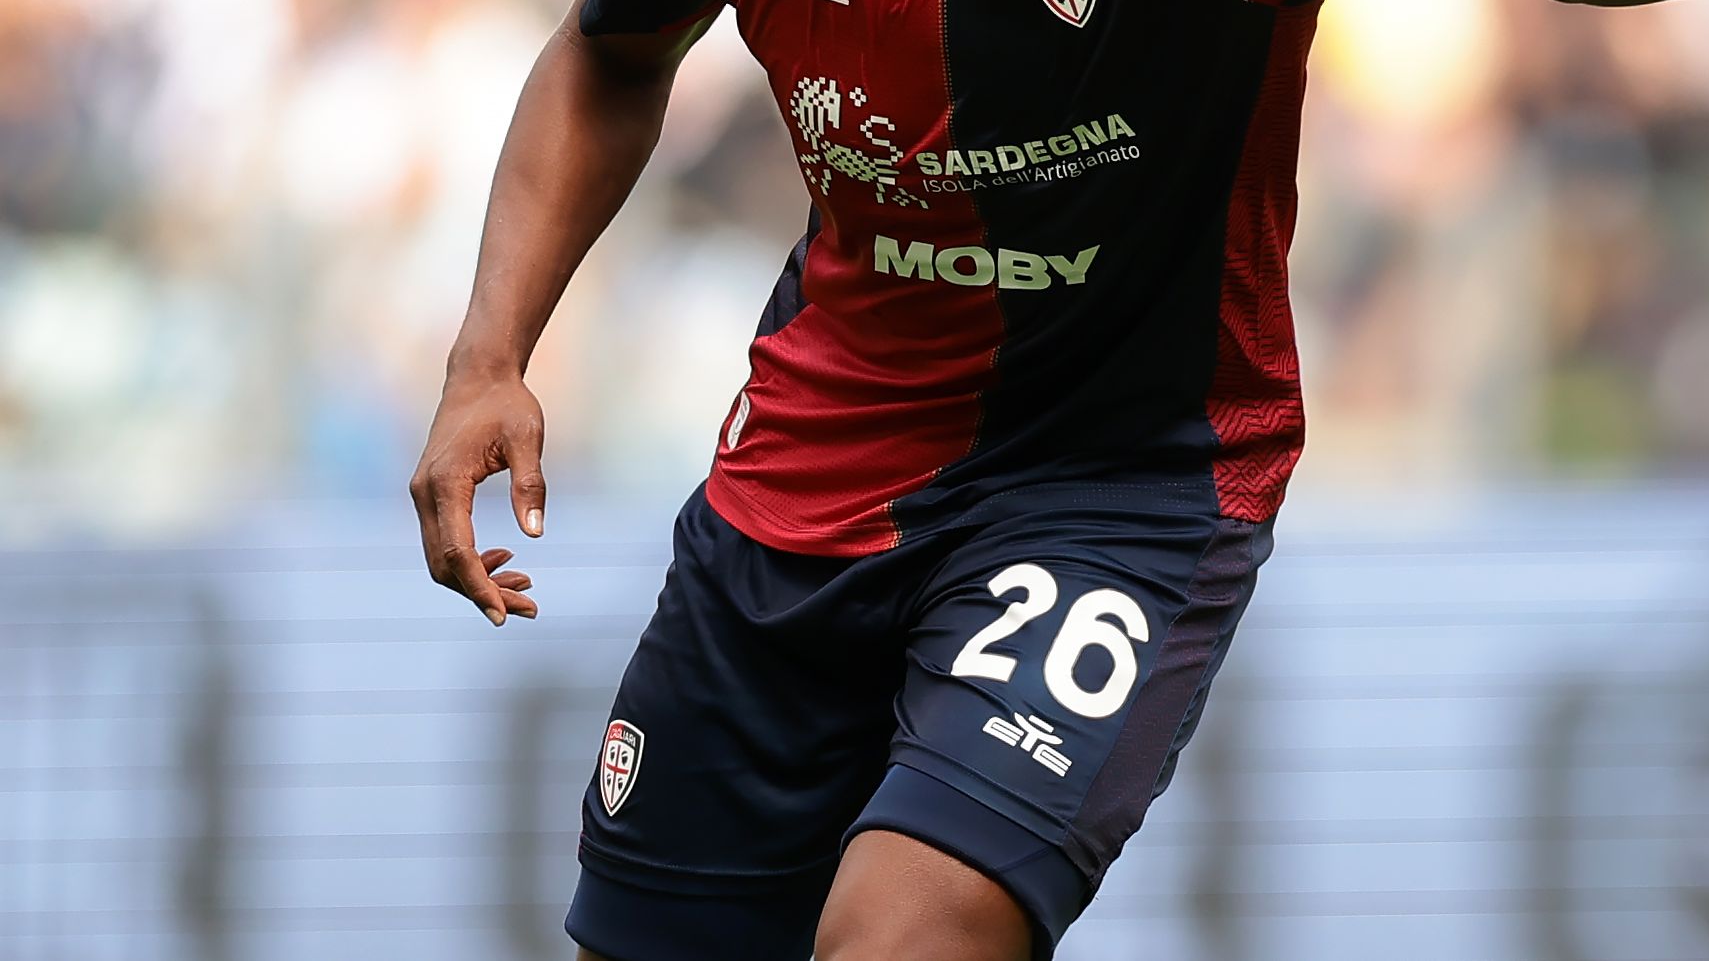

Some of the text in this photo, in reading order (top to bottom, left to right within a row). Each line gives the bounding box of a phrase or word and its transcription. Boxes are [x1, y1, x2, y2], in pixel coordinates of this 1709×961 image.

[915, 113, 1137, 176] SARDEGNA
[922, 144, 1141, 193] ISOLA dell'Artigianato
[875, 234, 1101, 290] MOBY
[950, 563, 1149, 718] 26
